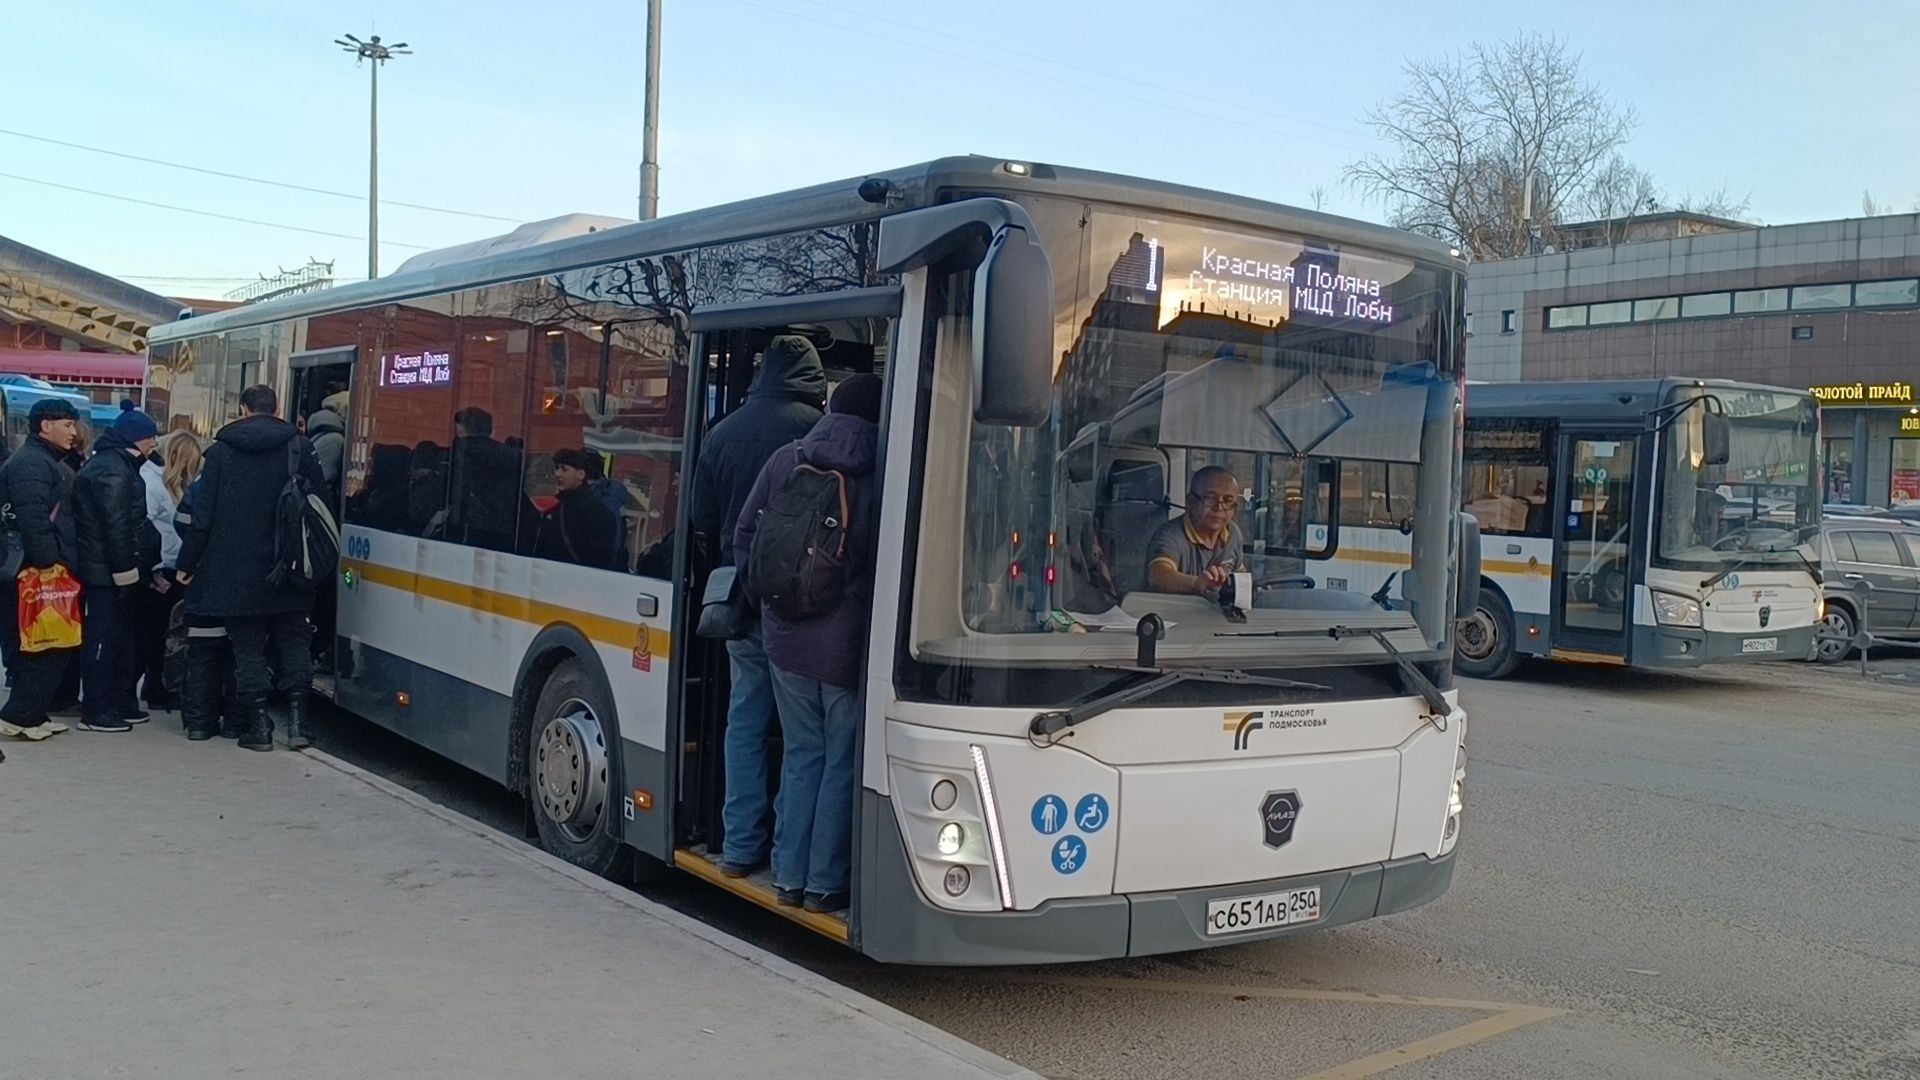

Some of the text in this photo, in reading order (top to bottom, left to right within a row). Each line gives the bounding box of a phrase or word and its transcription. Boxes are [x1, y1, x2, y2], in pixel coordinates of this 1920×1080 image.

[1145, 238, 1158, 291] 1
[1202, 246, 1380, 298] Красная Поляна
[1189, 270, 1392, 323] Станция МЦД Лобн
[1869, 383, 1911, 400] ПРАЙД
[1269, 719, 1328, 729] ПОДМОСКОВЬЯ
[1270, 709, 1315, 718] ТРАНСПОРТ
[1290, 890, 1316, 911] 250
